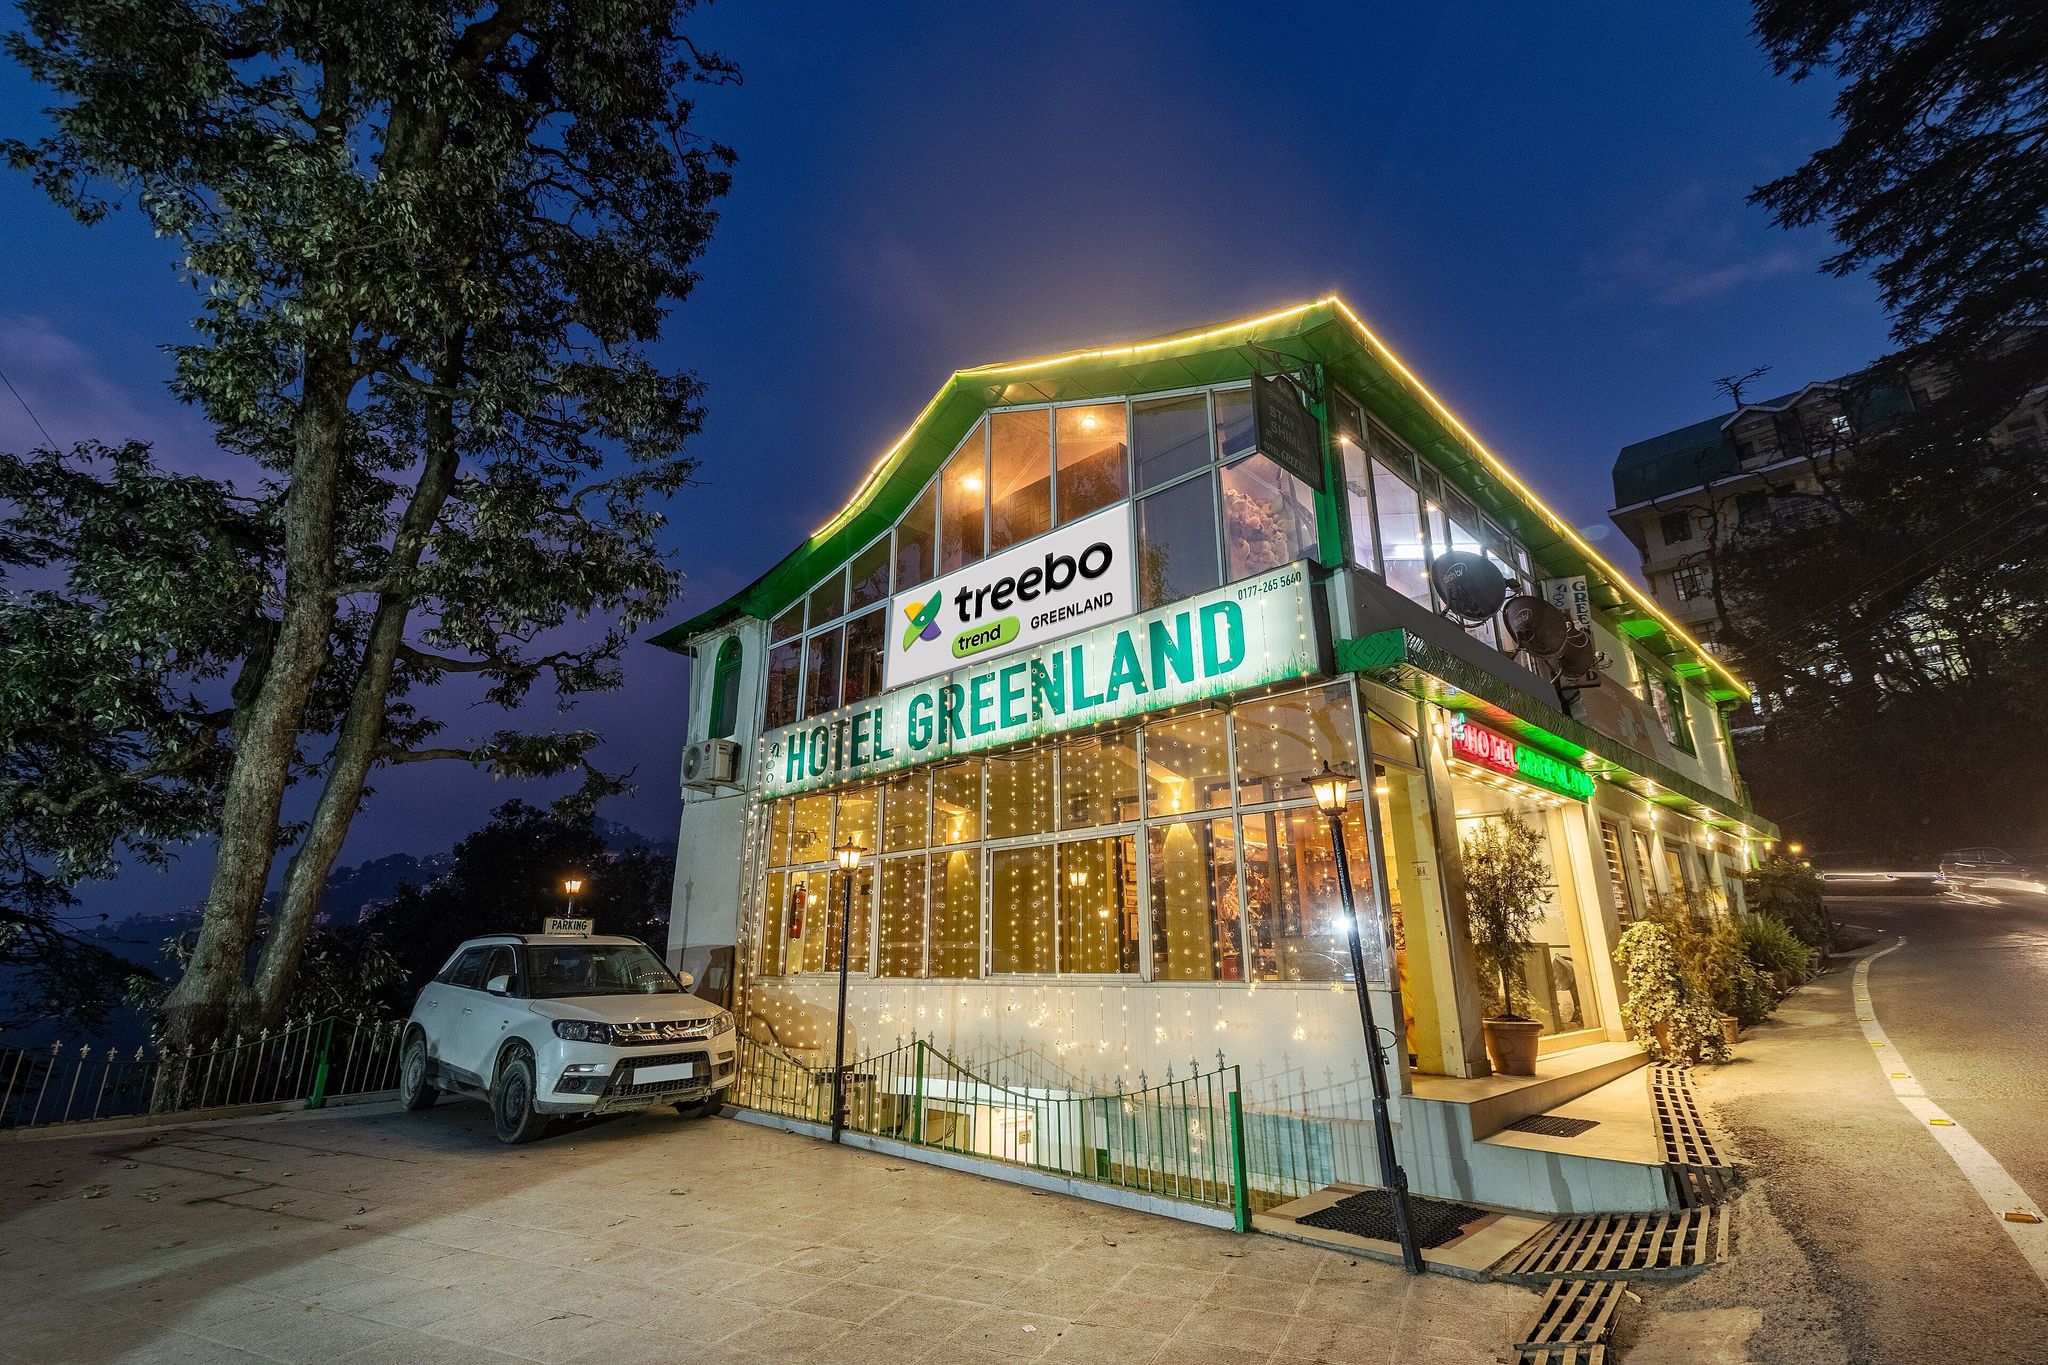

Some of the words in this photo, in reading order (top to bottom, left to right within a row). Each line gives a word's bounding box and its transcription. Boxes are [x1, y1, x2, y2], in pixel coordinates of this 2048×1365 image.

[1269, 405, 1295, 430] STAY
[954, 542, 1113, 623] treebo
[1237, 578, 1279, 601] 0177-265
[1280, 571, 1303, 588] 5640
[1030, 591, 1114, 630] GREENLAND
[957, 623, 1002, 651] trend
[786, 706, 894, 785] HOTEL
[907, 599, 1247, 752] GREENLAND
[1461, 723, 1518, 772] HOTEL
[551, 919, 587, 931] PARKING
